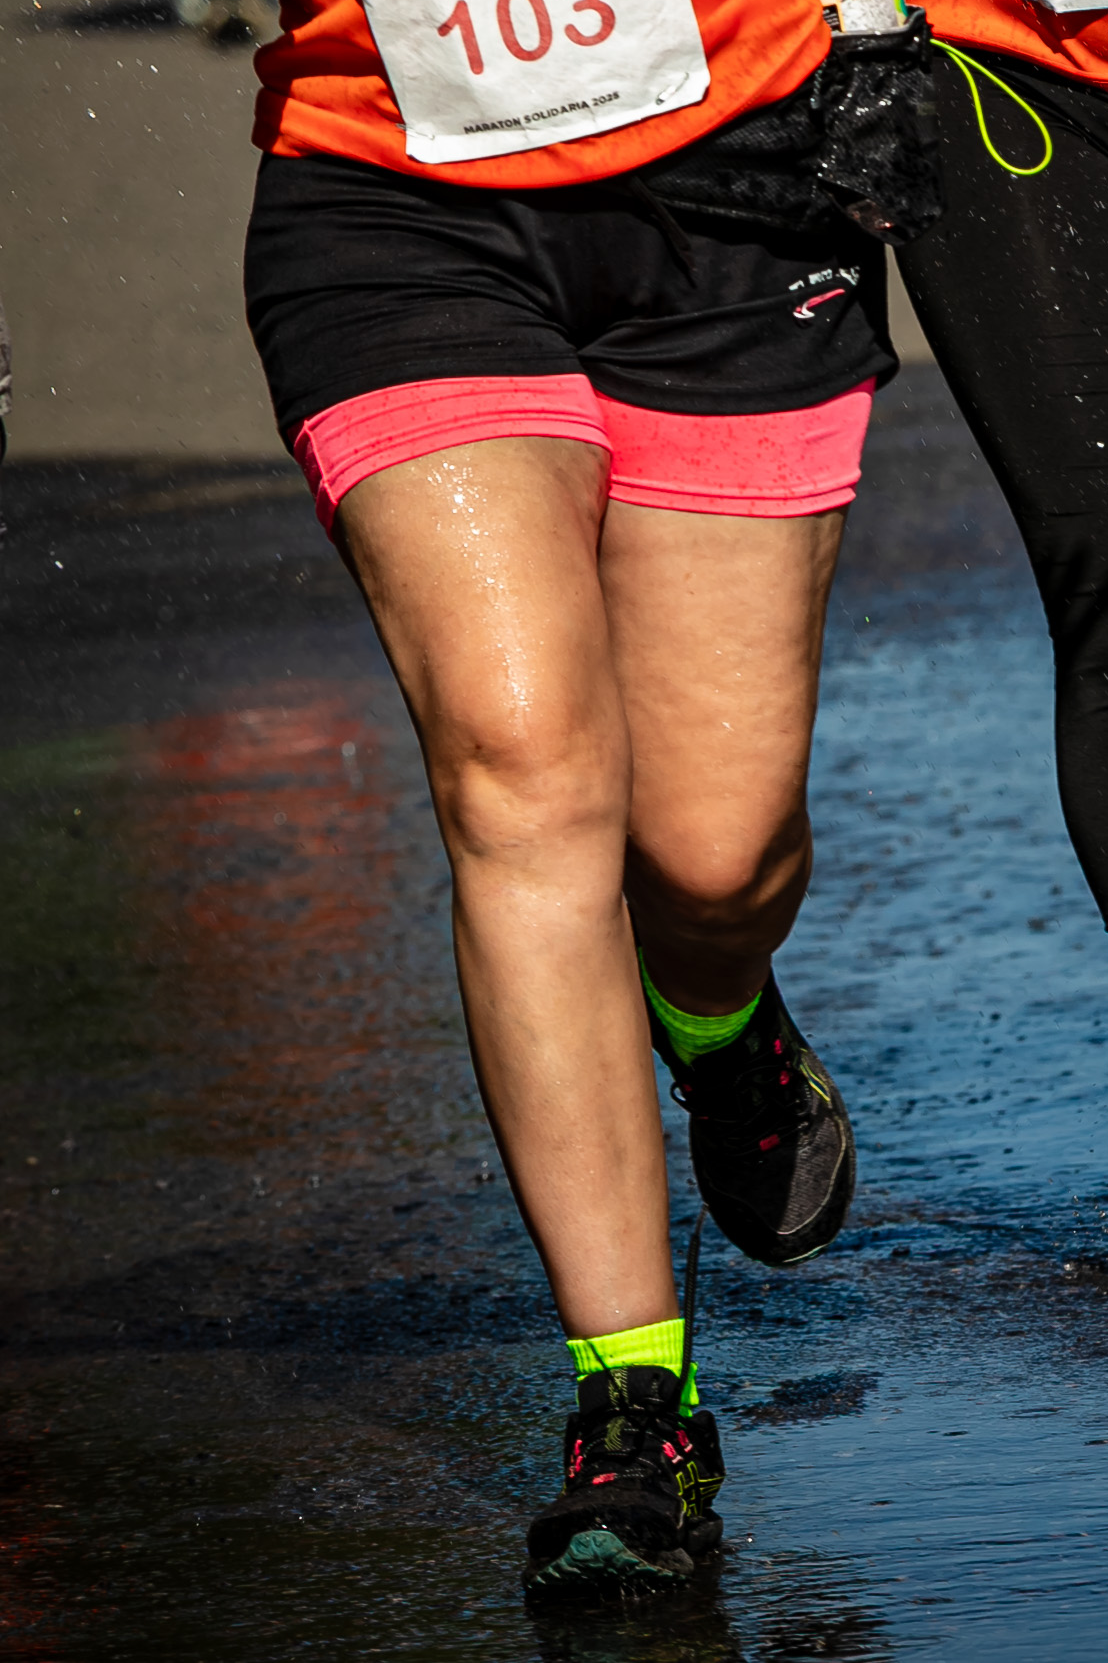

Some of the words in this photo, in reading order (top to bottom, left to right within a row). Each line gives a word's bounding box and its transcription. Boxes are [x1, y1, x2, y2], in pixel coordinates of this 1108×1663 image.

[463, 116, 522, 135] MARATON
[523, 100, 590, 125] SOLIDARIA
[591, 90, 620, 107] 2025
